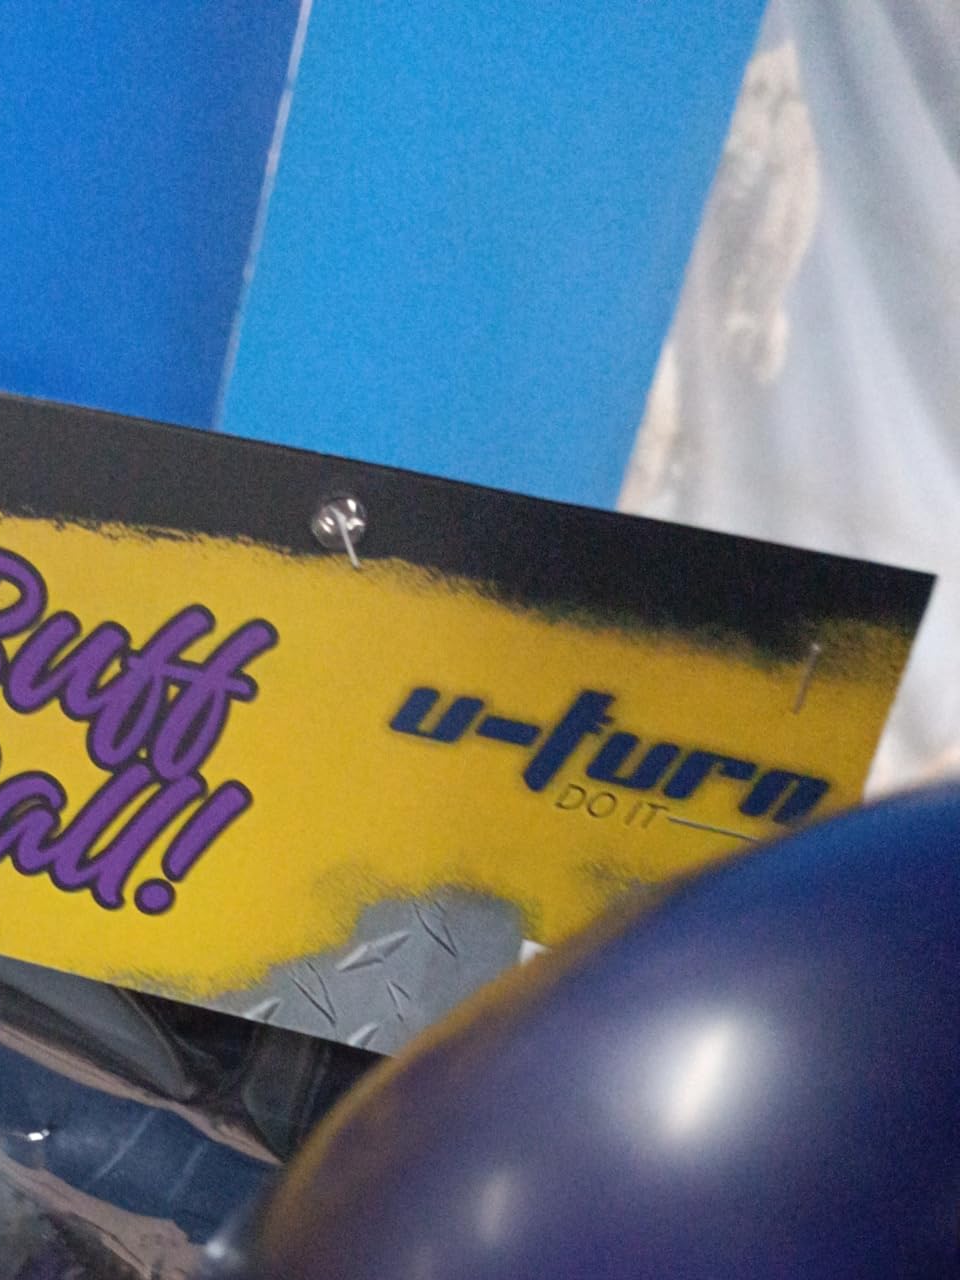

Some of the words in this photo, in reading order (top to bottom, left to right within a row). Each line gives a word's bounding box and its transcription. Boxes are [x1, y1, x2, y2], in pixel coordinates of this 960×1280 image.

[389, 686, 831, 824] u-turn
[555, 783, 619, 819] DO
[626, 800, 670, 831] IT
